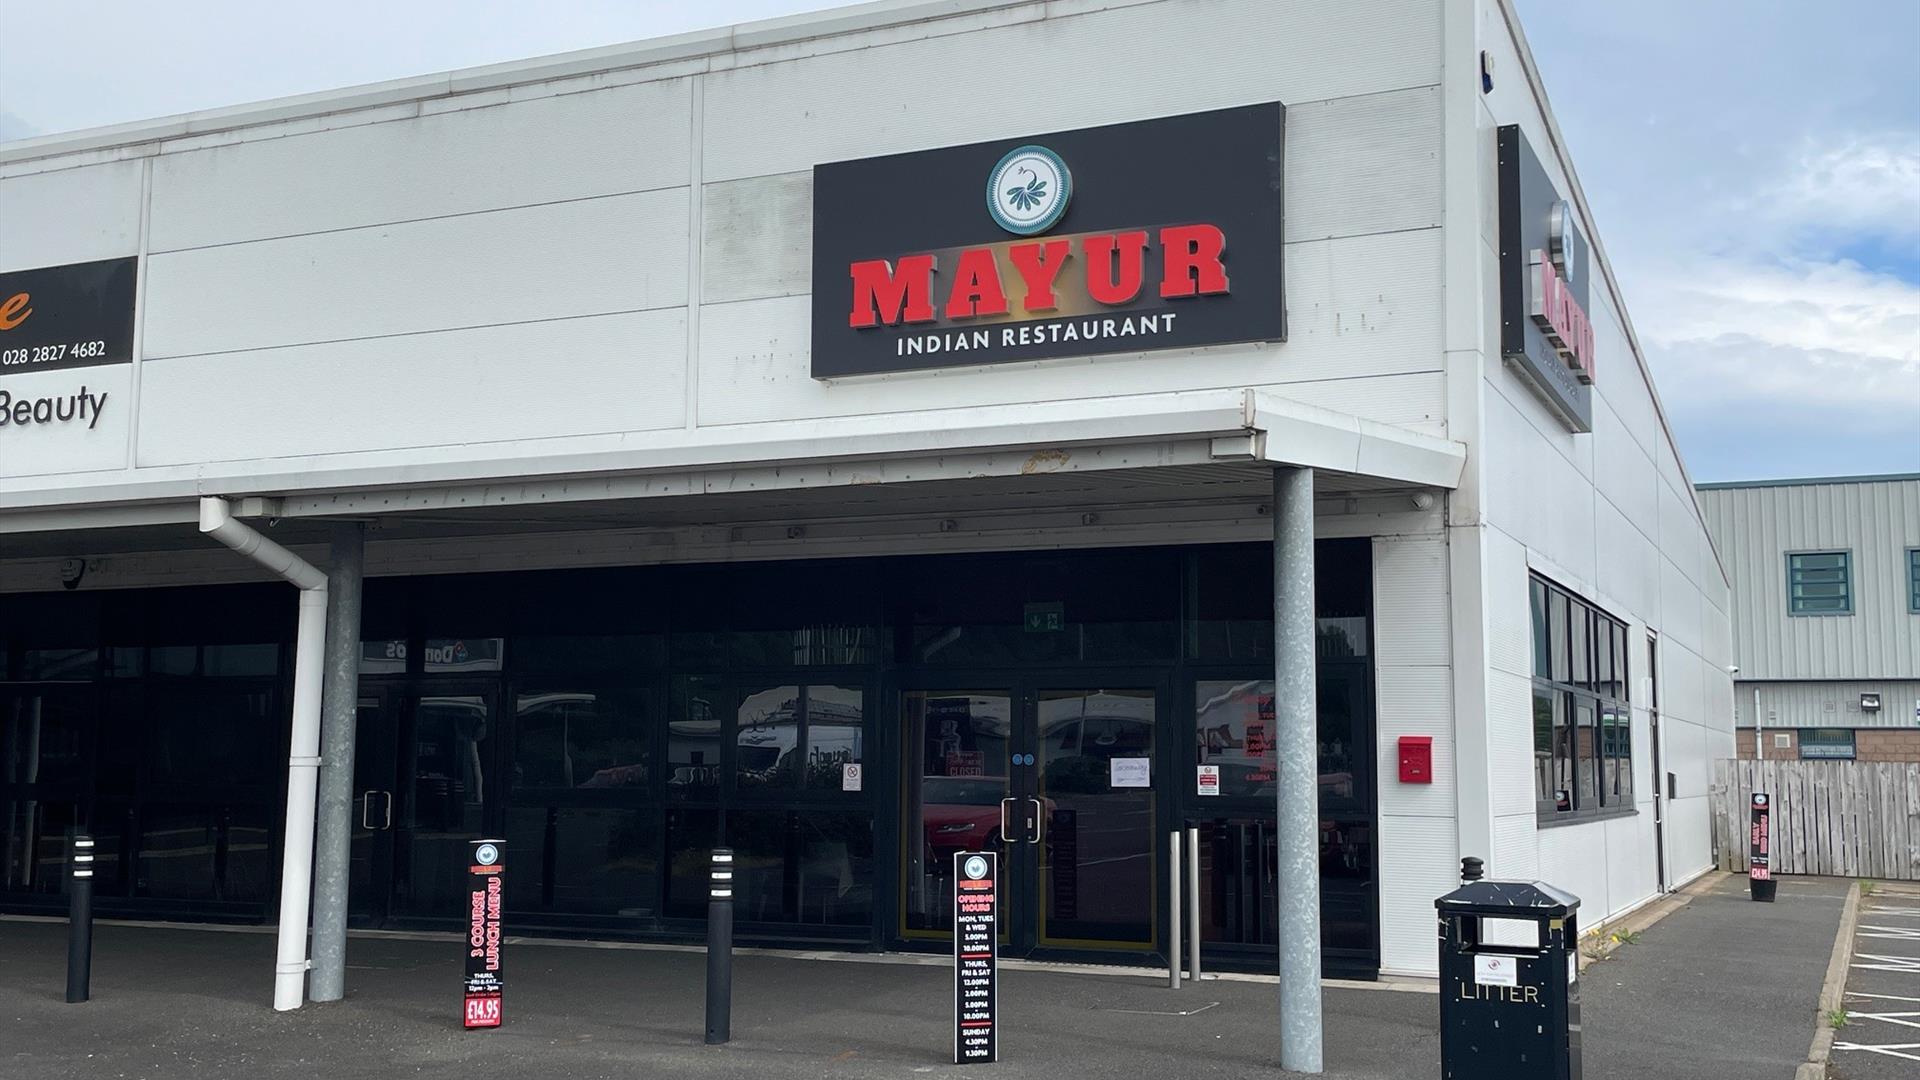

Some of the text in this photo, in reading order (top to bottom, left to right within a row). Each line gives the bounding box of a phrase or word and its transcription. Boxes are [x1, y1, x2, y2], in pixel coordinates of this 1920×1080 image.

[850, 224, 1230, 328] MAYUR
[897, 313, 1176, 356] INDIAN RESTAURANT
[3, 340, 105, 365] 028 2827 4682
[950, 767, 981, 777] CLOSED
[958, 894, 994, 903] OPENING
[962, 904, 990, 912] HOURS
[470, 890, 485, 958] 3 COURSE
[486, 877, 501, 970] LUNCH MENU
[1461, 982, 1538, 1003] LITTER
[468, 1000, 498, 1020] £14.95
[963, 1028, 990, 1036] SUNDAY
